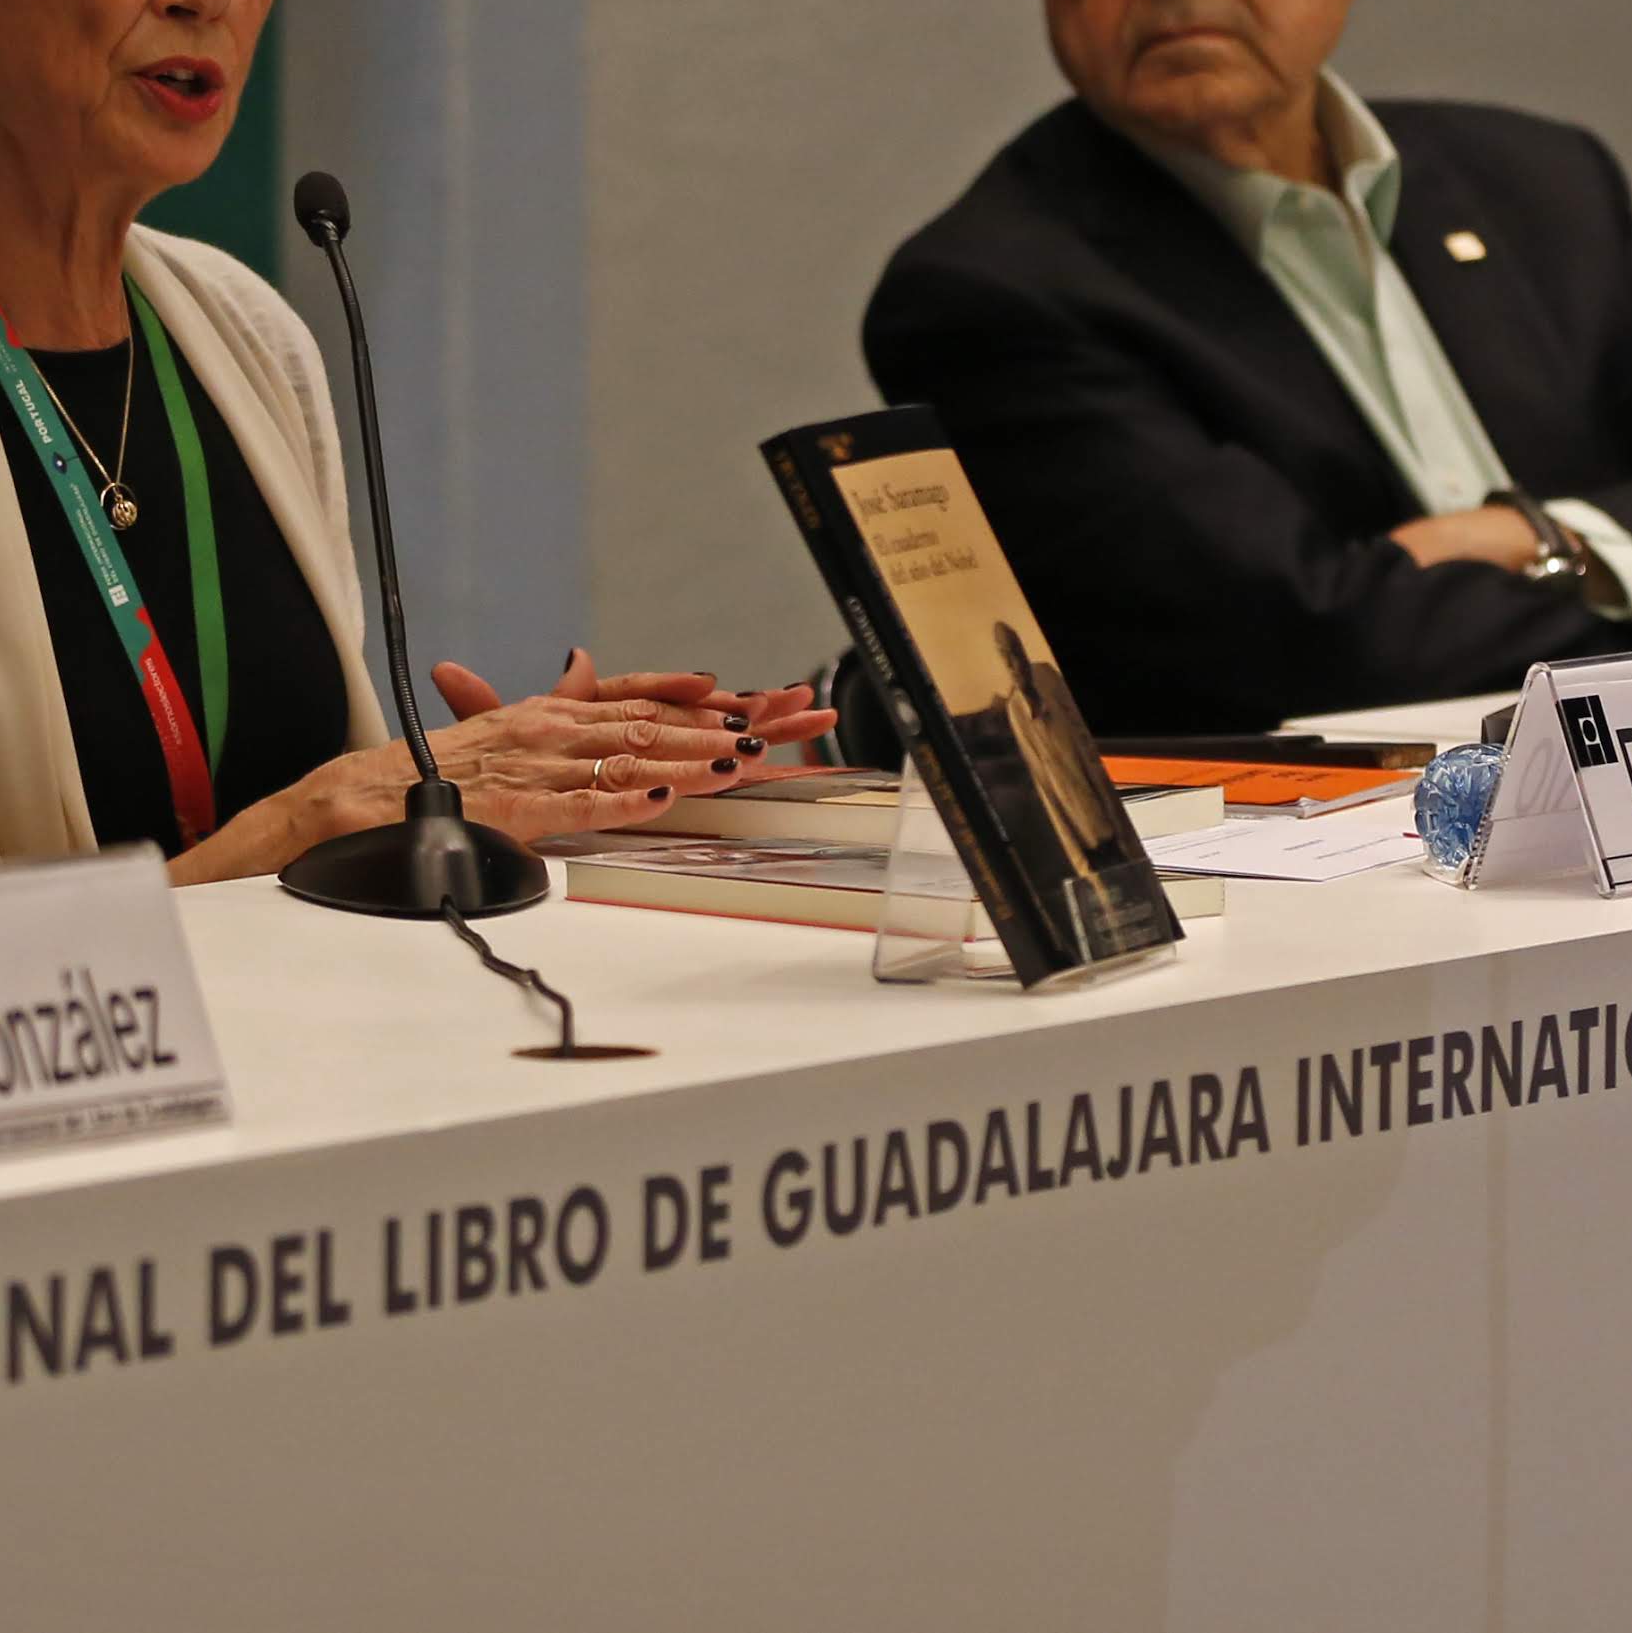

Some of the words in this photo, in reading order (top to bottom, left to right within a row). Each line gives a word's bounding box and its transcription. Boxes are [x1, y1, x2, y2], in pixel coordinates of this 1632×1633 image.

[15, 379, 53, 444] PORTUGAL
[208, 1228, 351, 1348] DEL
[383, 1184, 611, 1317] LIBRO
[643, 1164, 731, 1271] DE
[761, 1065, 1270, 1248] GUADALAJARA
